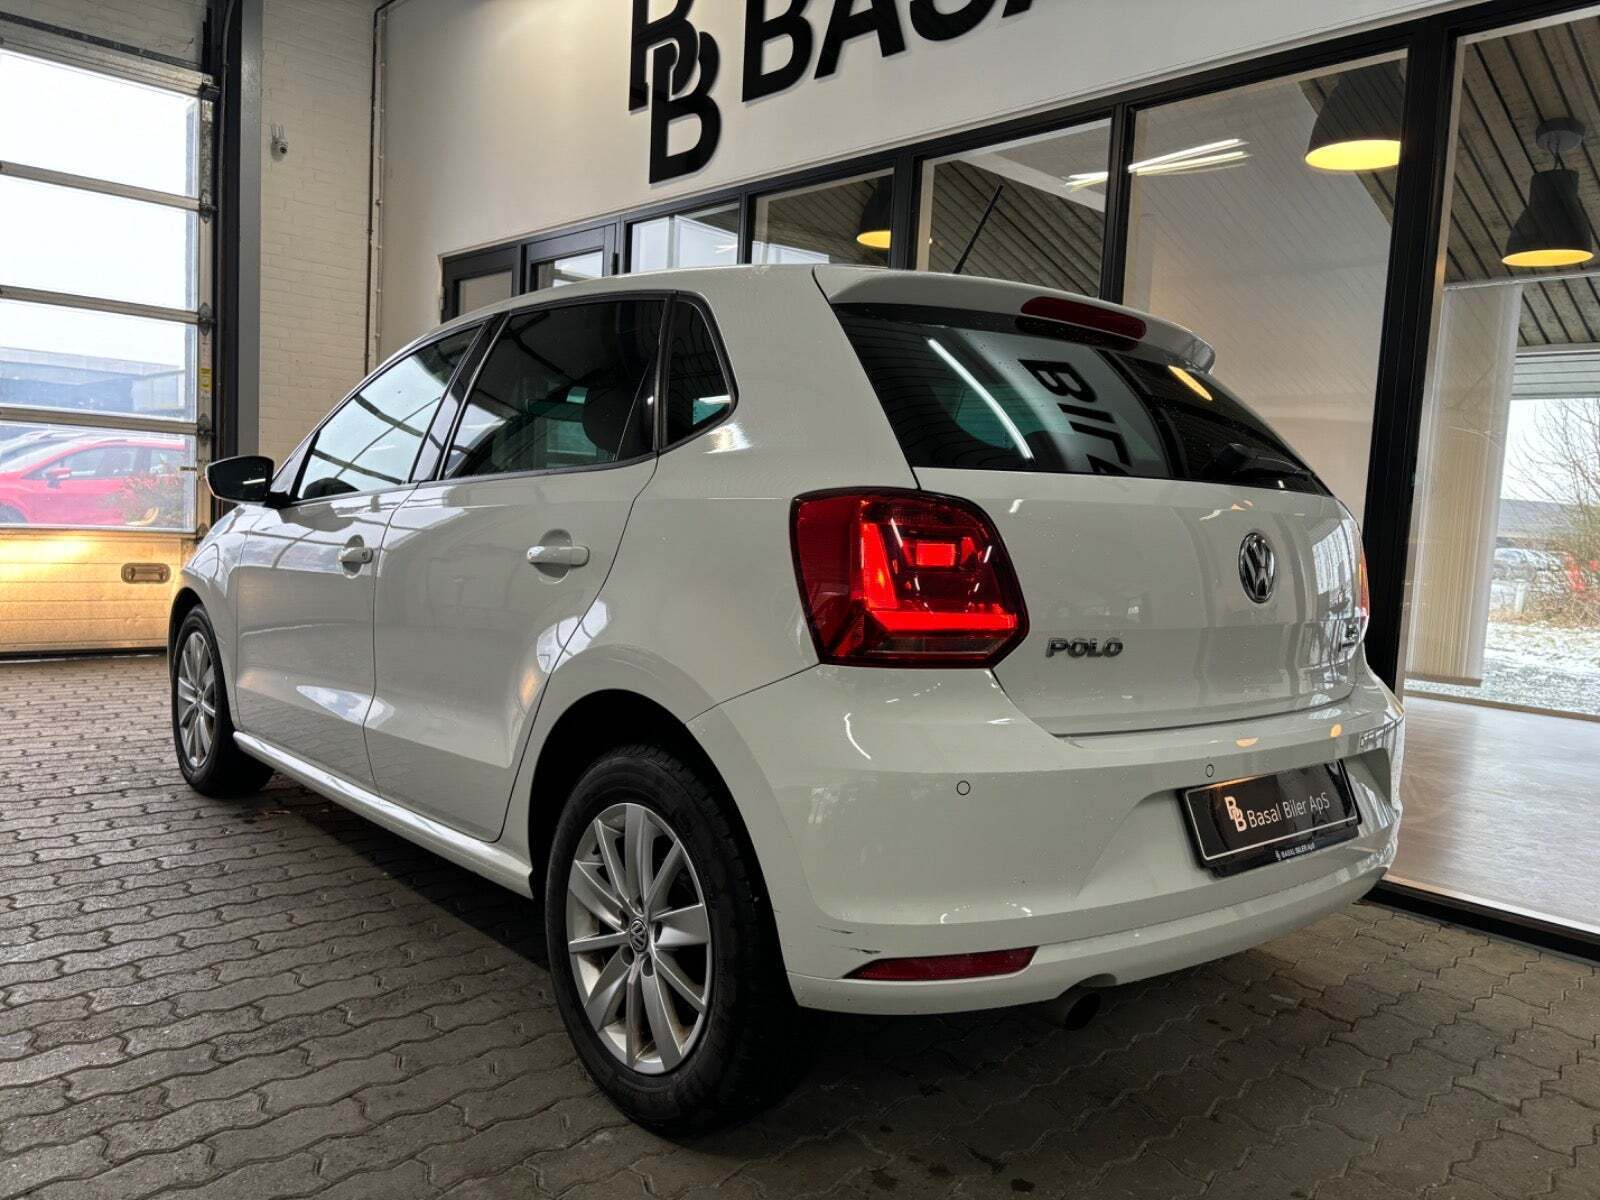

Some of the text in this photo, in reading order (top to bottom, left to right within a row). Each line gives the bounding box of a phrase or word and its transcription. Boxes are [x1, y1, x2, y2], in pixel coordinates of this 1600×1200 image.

[1045, 637, 1124, 659] POLO
[1247, 792, 1330, 828] Basal Biler ApS
